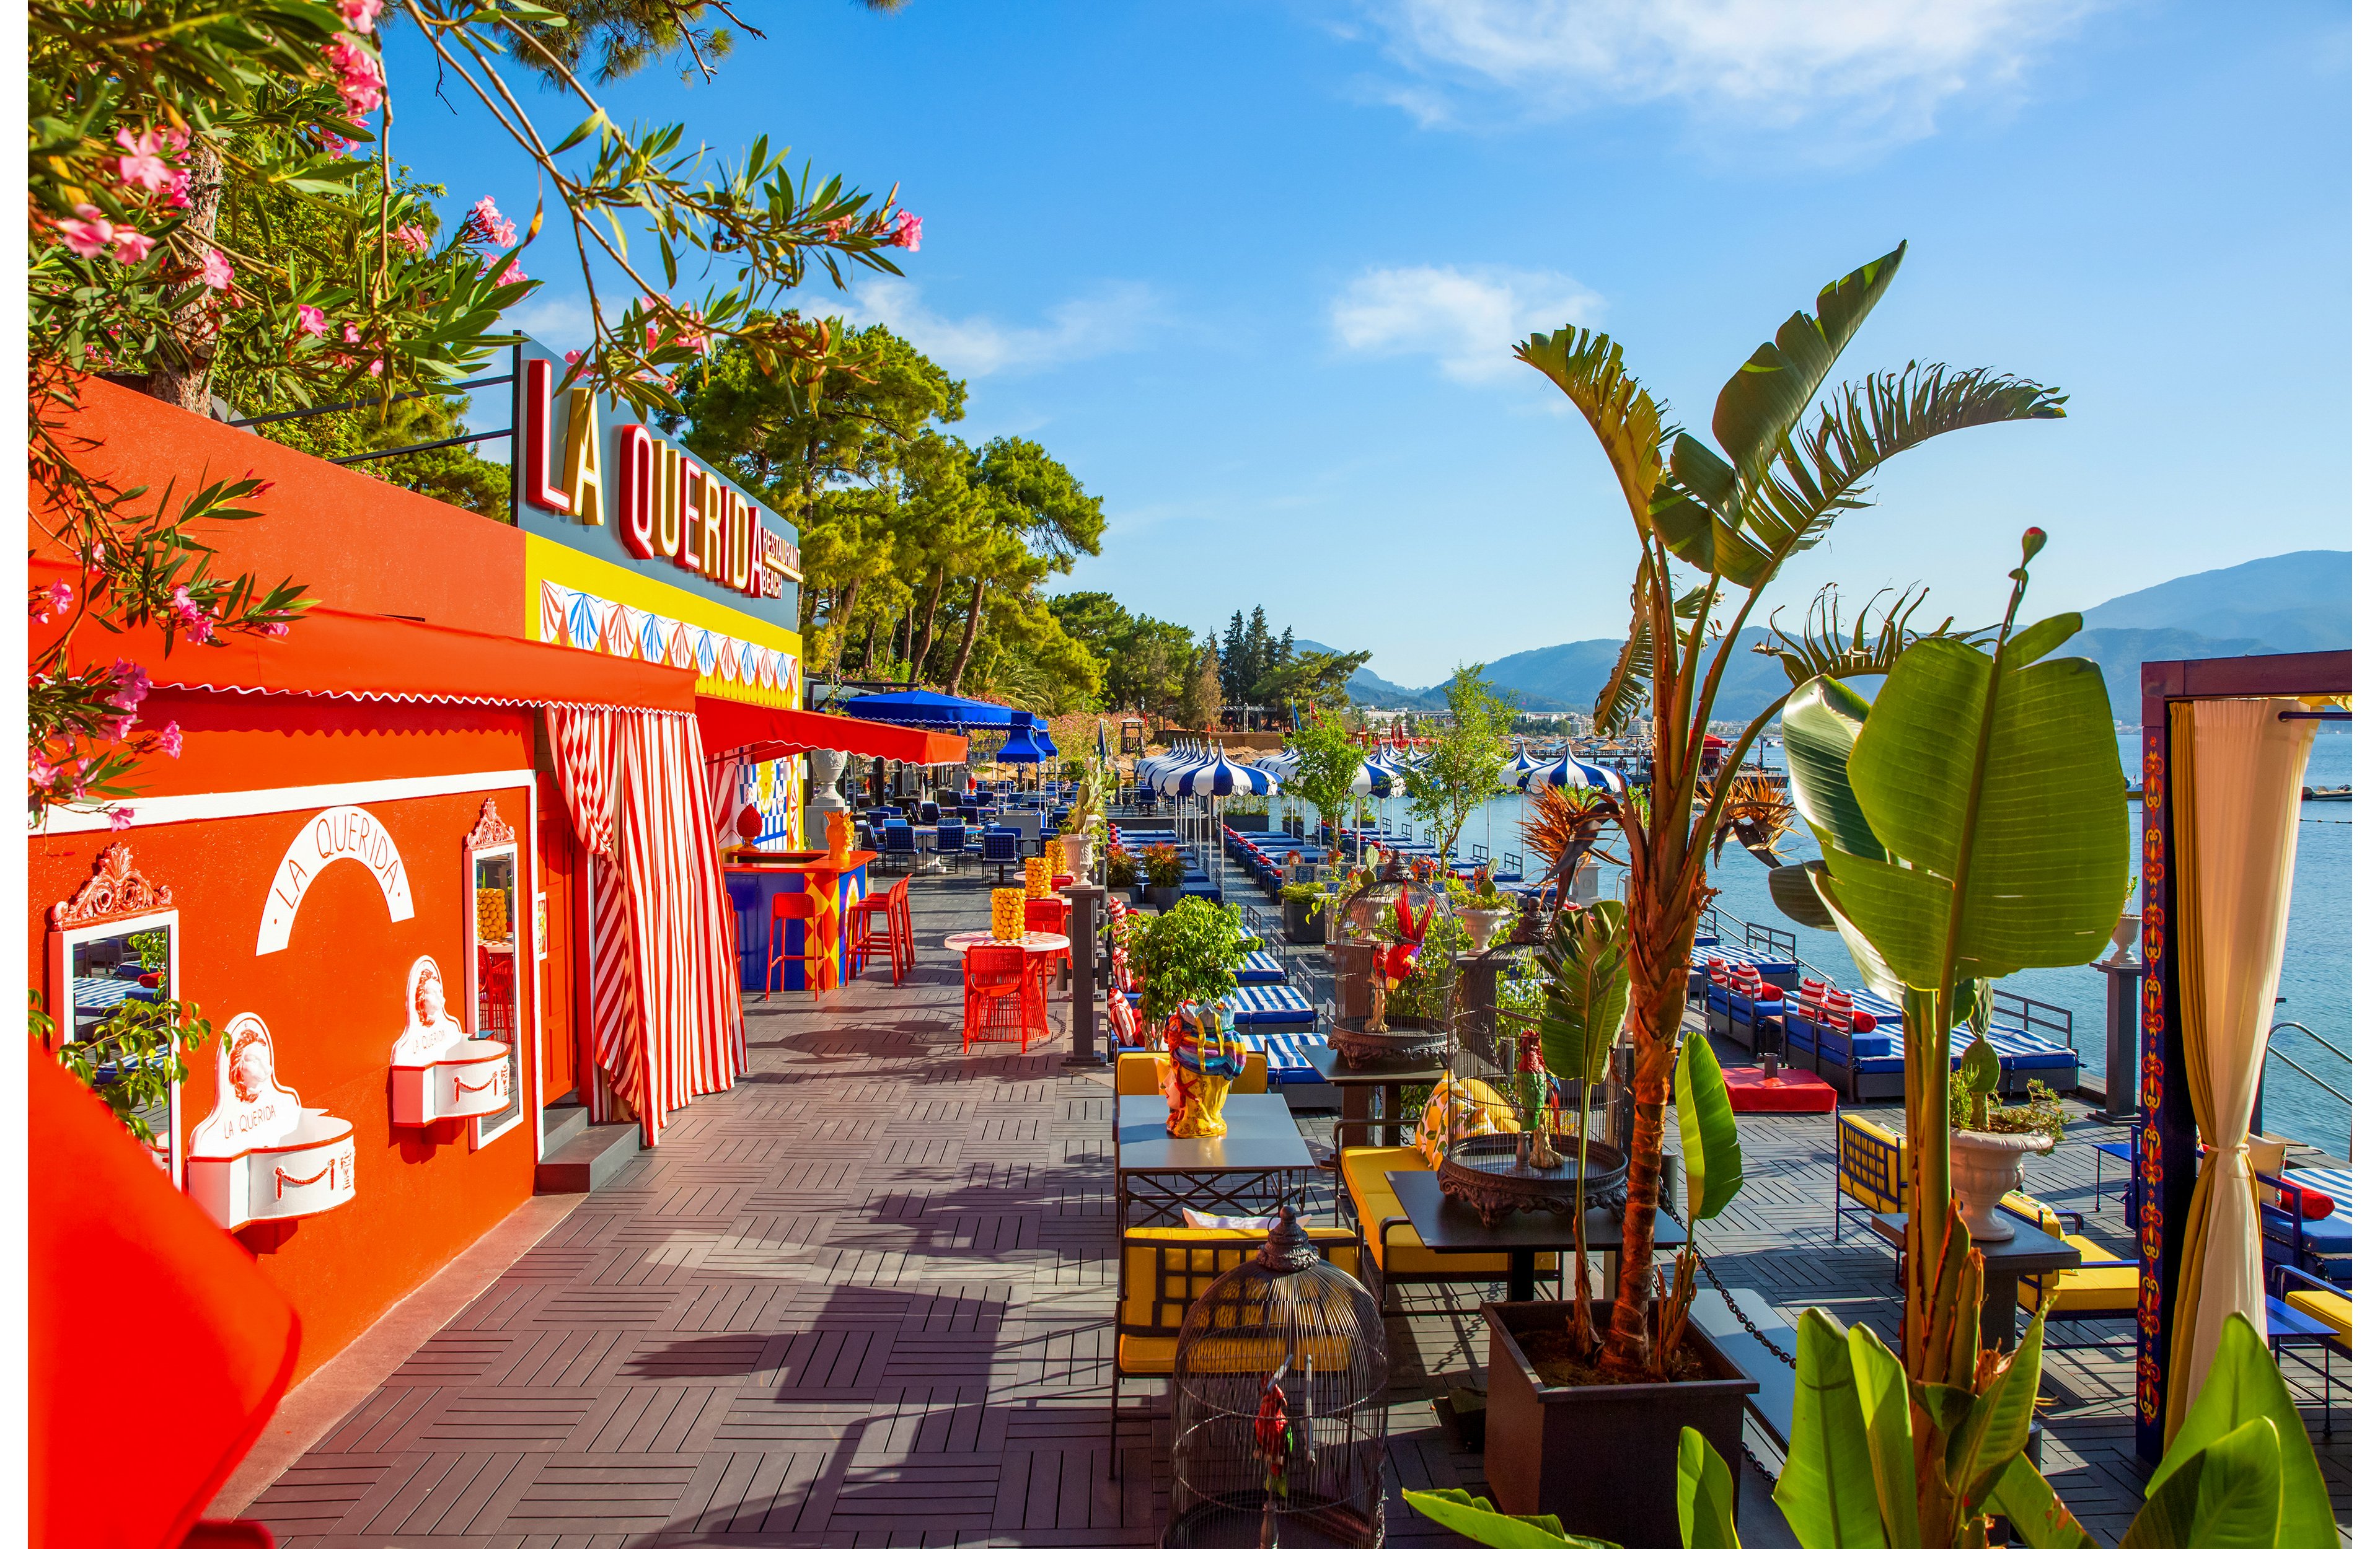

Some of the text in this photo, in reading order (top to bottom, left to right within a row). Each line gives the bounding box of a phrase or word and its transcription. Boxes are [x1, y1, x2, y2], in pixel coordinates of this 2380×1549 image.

[527, 359, 763, 599] LA QUERIDA
[762, 527, 801, 573] RESTAURANT
[762, 565, 782, 599] BEACH
[276, 813, 399, 910] LA QUERIDA
[224, 1104, 276, 1139] LA QUERIDA
